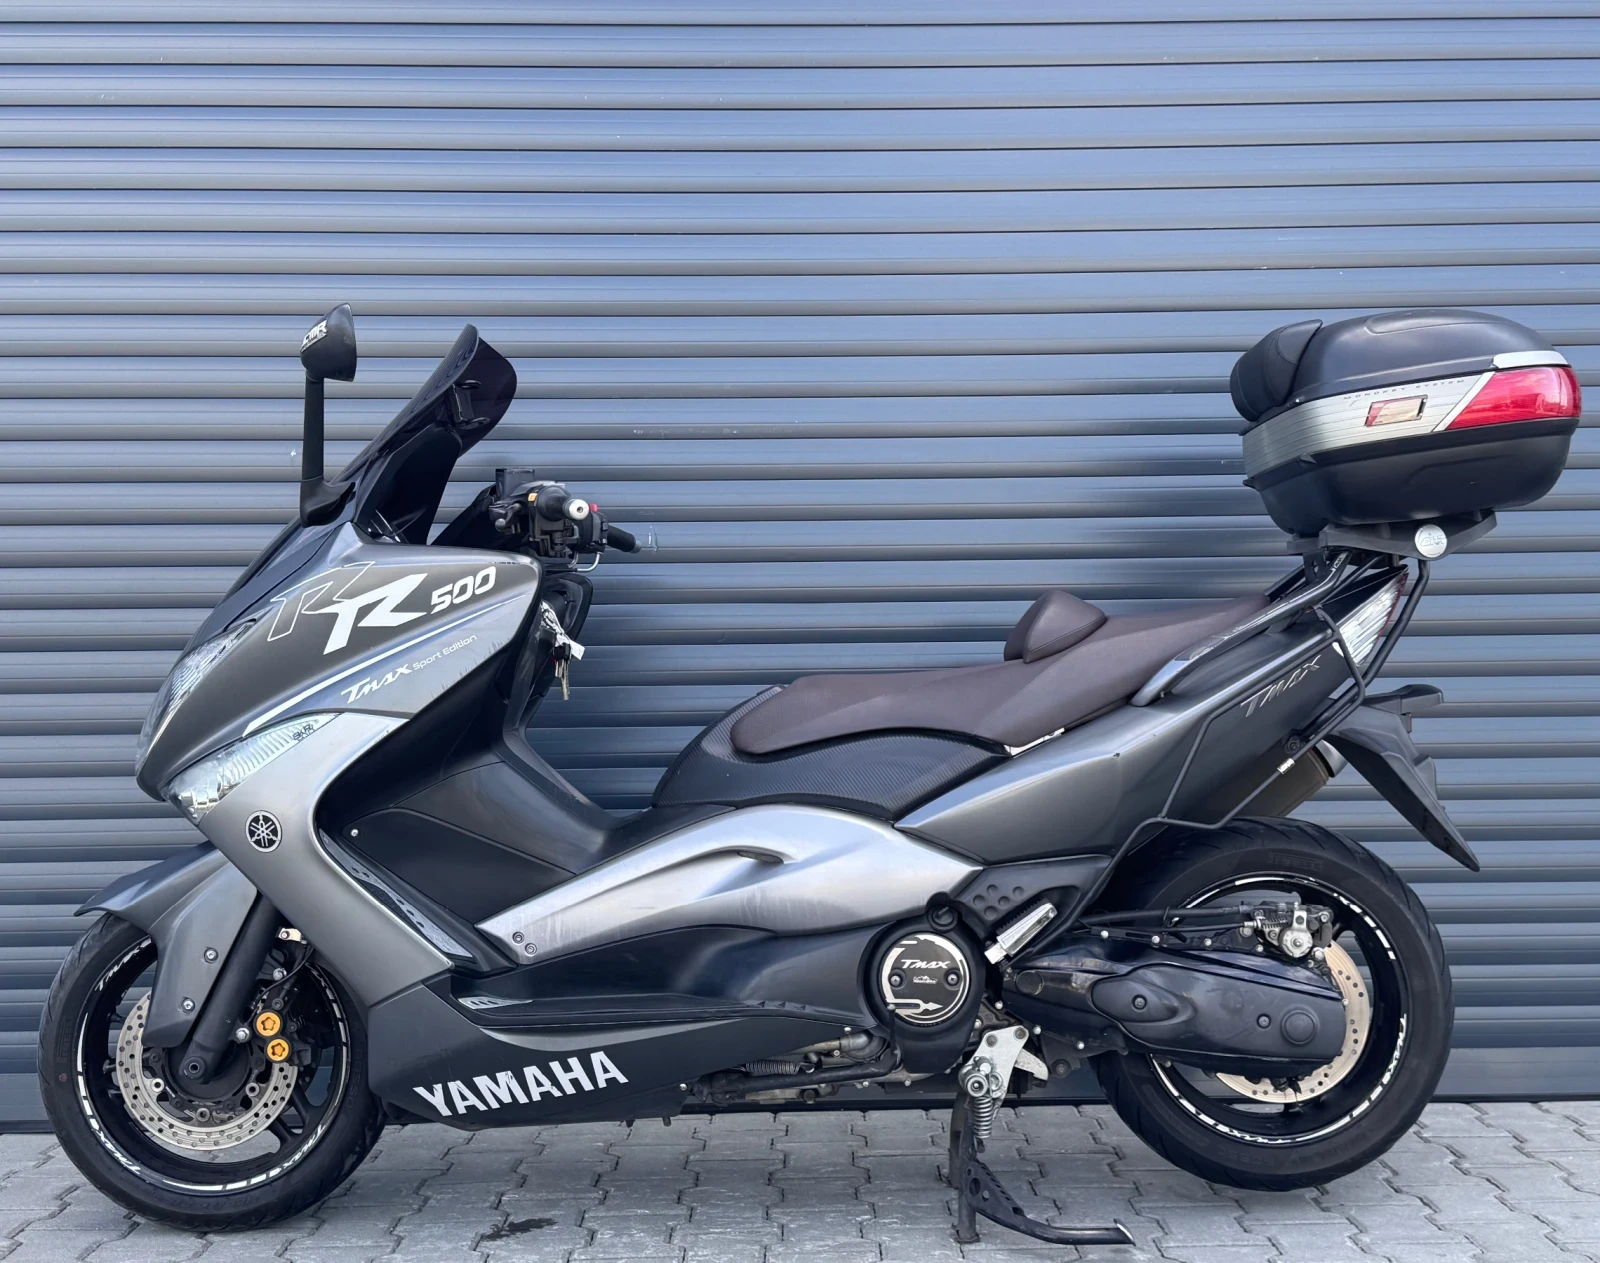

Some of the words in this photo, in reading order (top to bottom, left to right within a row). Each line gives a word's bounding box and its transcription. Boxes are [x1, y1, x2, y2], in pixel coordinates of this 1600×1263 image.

[431, 566, 497, 614] 500
[413, 650, 443, 671] Sport
[443, 634, 478, 656] Edition
[412, 1050, 630, 1118] YAMAHA
